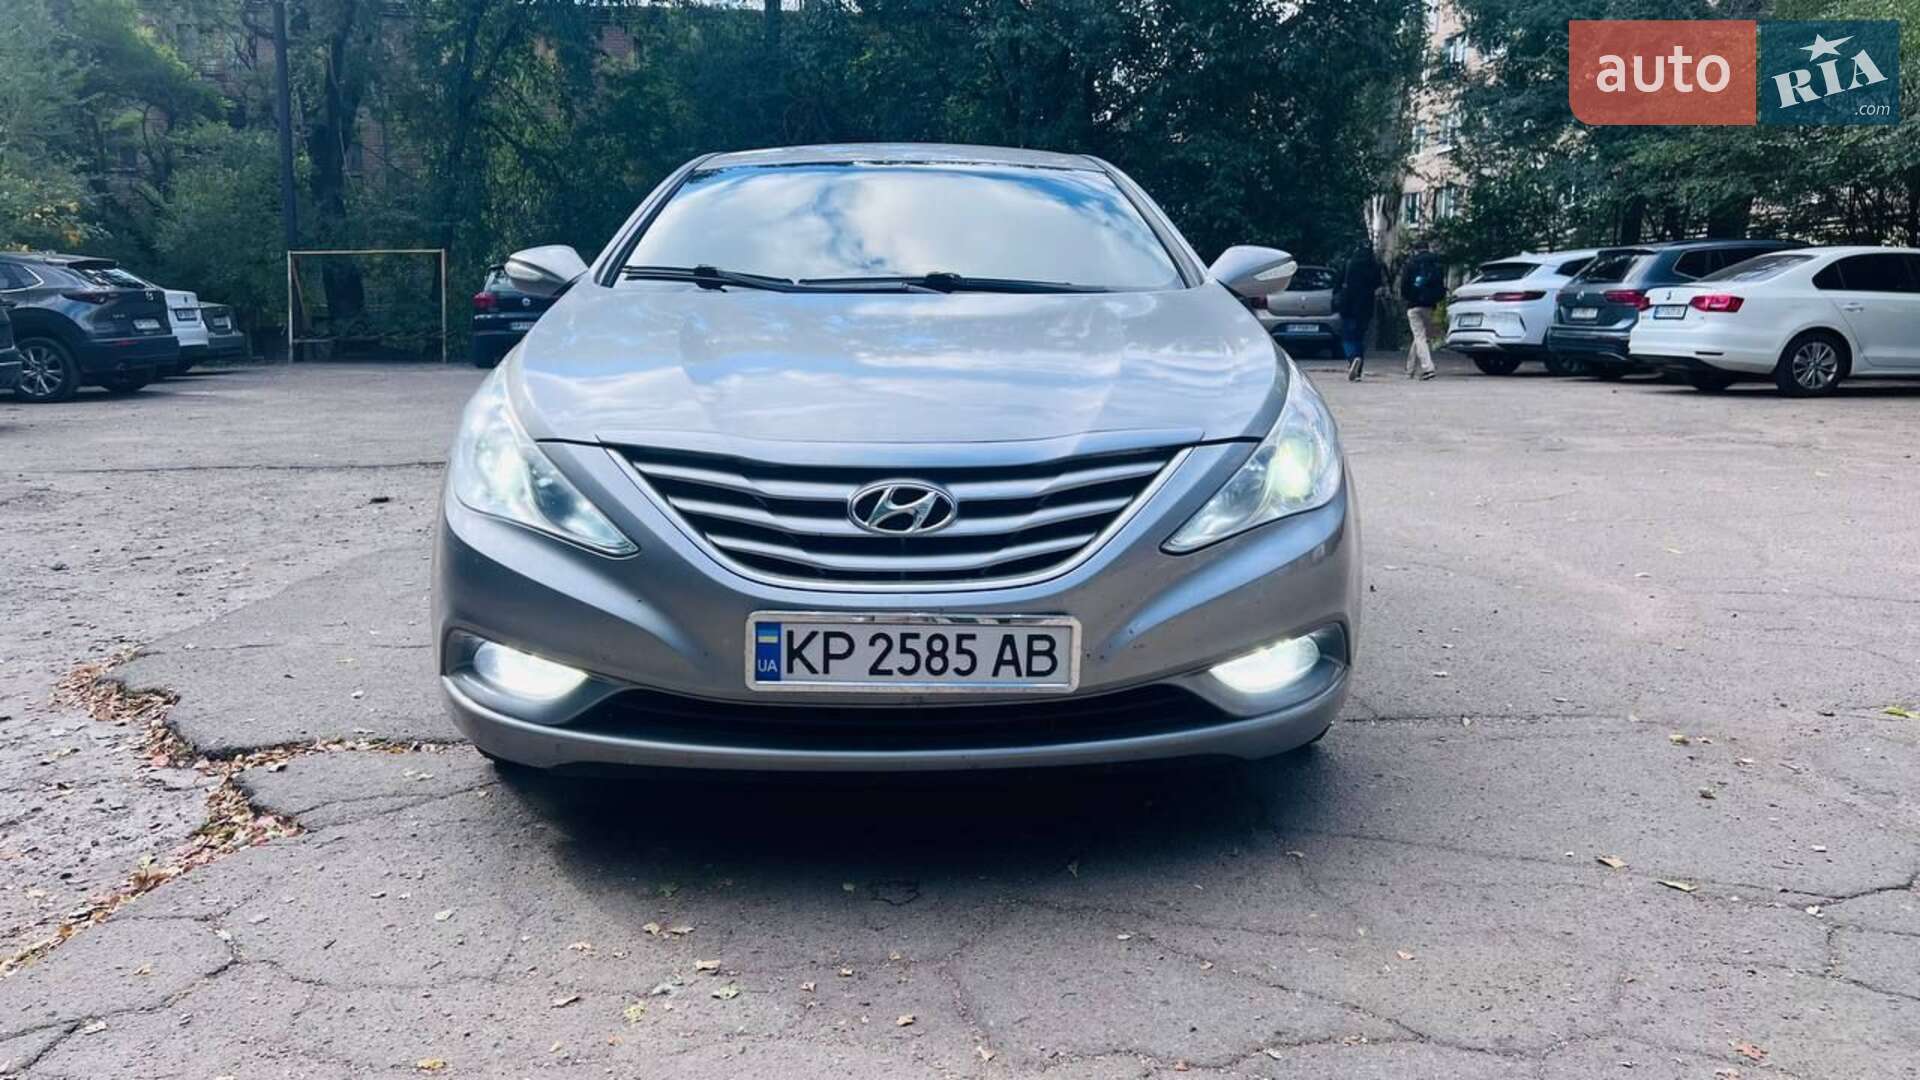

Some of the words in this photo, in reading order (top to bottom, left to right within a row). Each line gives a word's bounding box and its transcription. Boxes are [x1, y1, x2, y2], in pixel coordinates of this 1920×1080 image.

[757, 659, 778, 673] UA
[785, 630, 855, 675] KP
[867, 633, 977, 677] 2585
[991, 634, 1058, 677] AB
